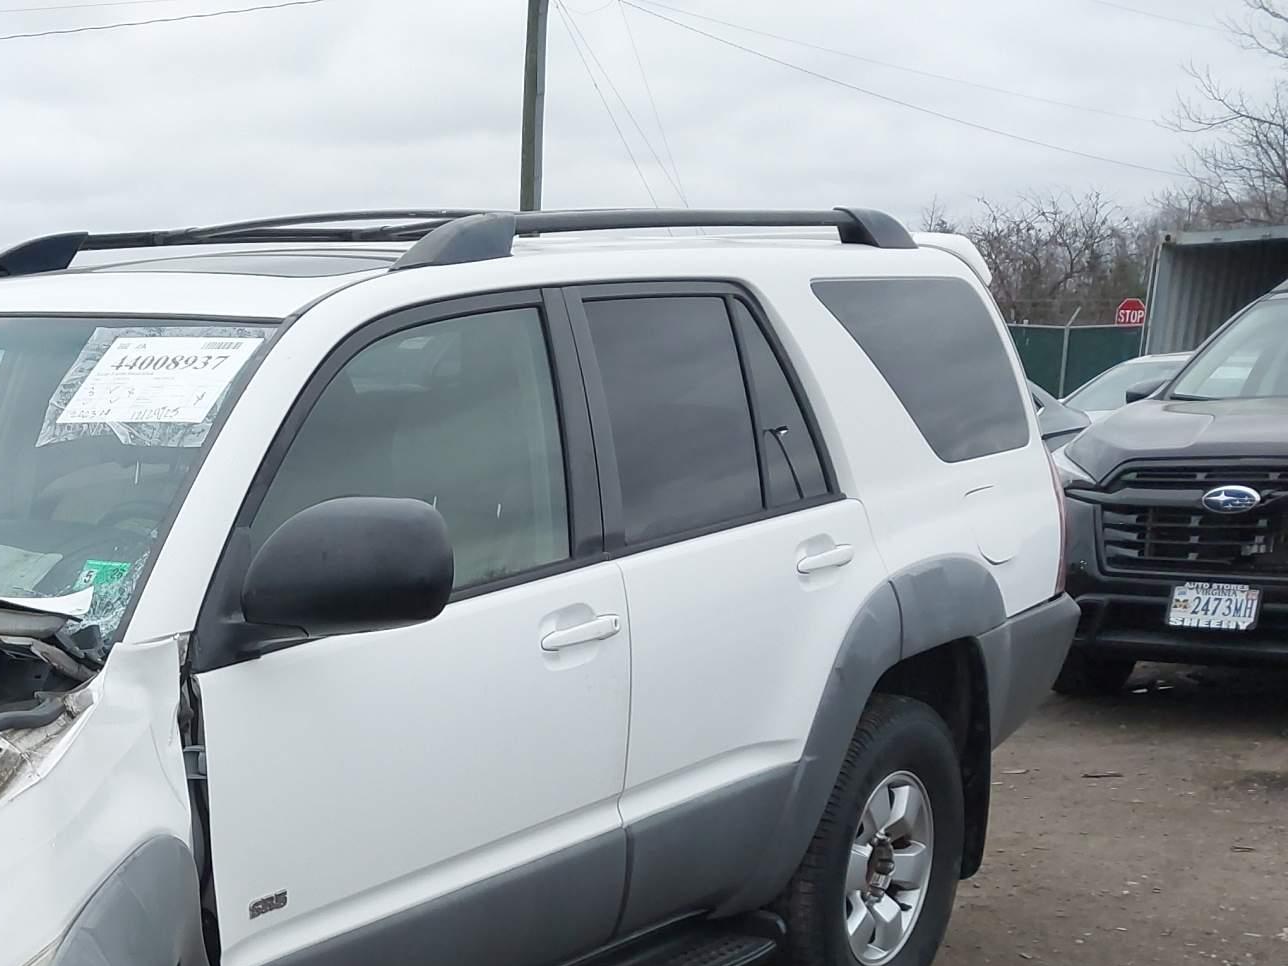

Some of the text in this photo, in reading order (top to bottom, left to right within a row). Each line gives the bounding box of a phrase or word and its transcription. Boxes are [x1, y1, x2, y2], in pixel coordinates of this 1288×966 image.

[1118, 309, 1144, 323] STOP
[110, 355, 231, 371] 44008937
[84, 571, 94, 583] 5
[1195, 588, 1237, 597] VIRGINIA
[1212, 583, 1249, 591] STORES
[1190, 596, 1255, 619] 2473MH
[1169, 617, 1253, 630] SHEEHY
[249, 888, 288, 920] SR5
